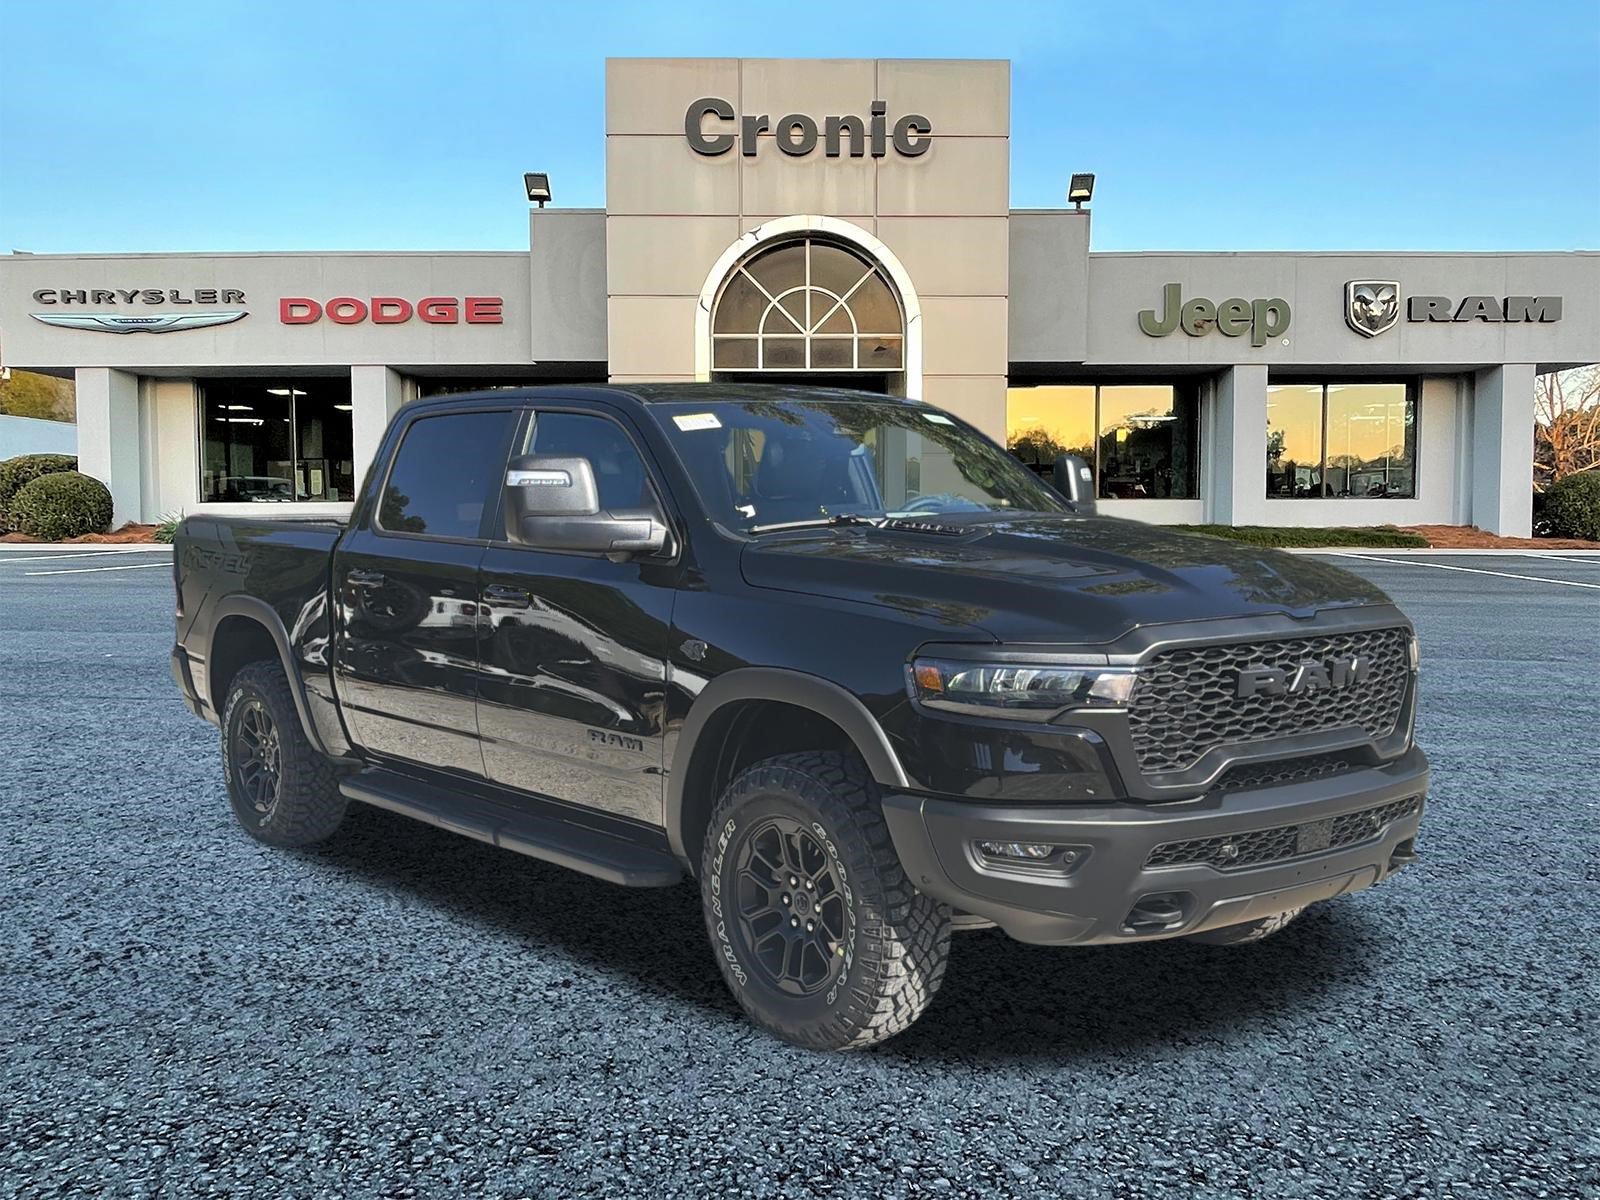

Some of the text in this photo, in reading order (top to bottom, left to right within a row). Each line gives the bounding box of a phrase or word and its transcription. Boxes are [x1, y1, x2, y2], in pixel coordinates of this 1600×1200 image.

[685, 97, 932, 157] Cronic
[32, 288, 247, 305] CHRYSLER
[280, 296, 504, 325] DODGE
[1407, 296, 1563, 322] RAM
[1138, 283, 1291, 347] Jeep
[1237, 656, 1370, 698] RAM
[588, 729, 643, 751] RAM
[711, 819, 747, 986] WRANGLER
